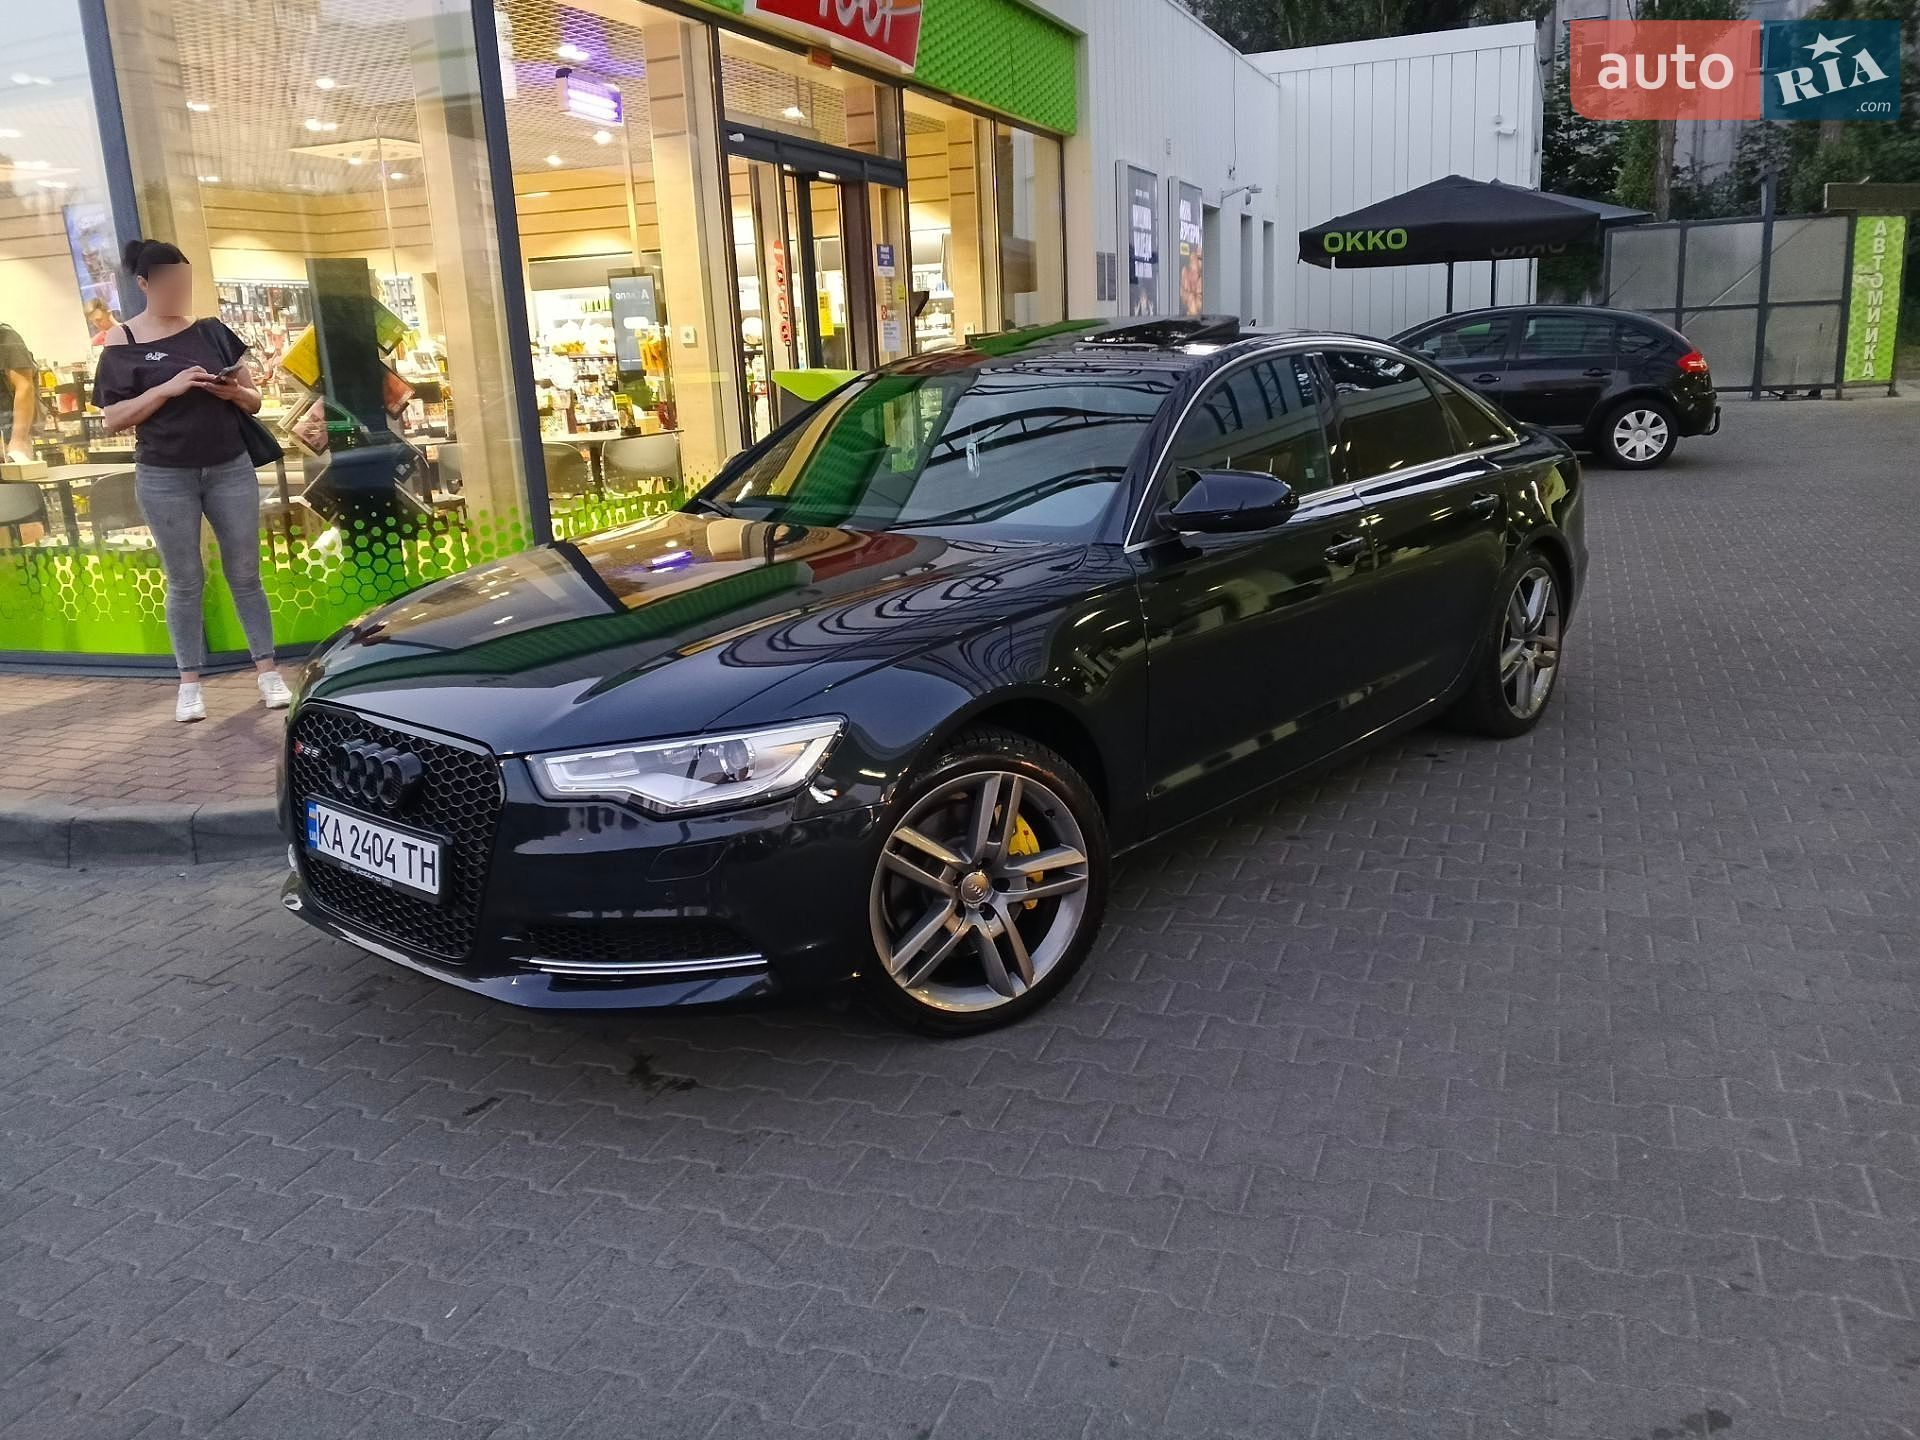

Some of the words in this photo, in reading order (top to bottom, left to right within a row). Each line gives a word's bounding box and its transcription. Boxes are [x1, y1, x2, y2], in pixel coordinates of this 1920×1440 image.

[1323, 227, 1408, 253] OKKO
[317, 811, 345, 855] KA
[349, 824, 397, 874] 2404
[401, 841, 437, 887] TH
